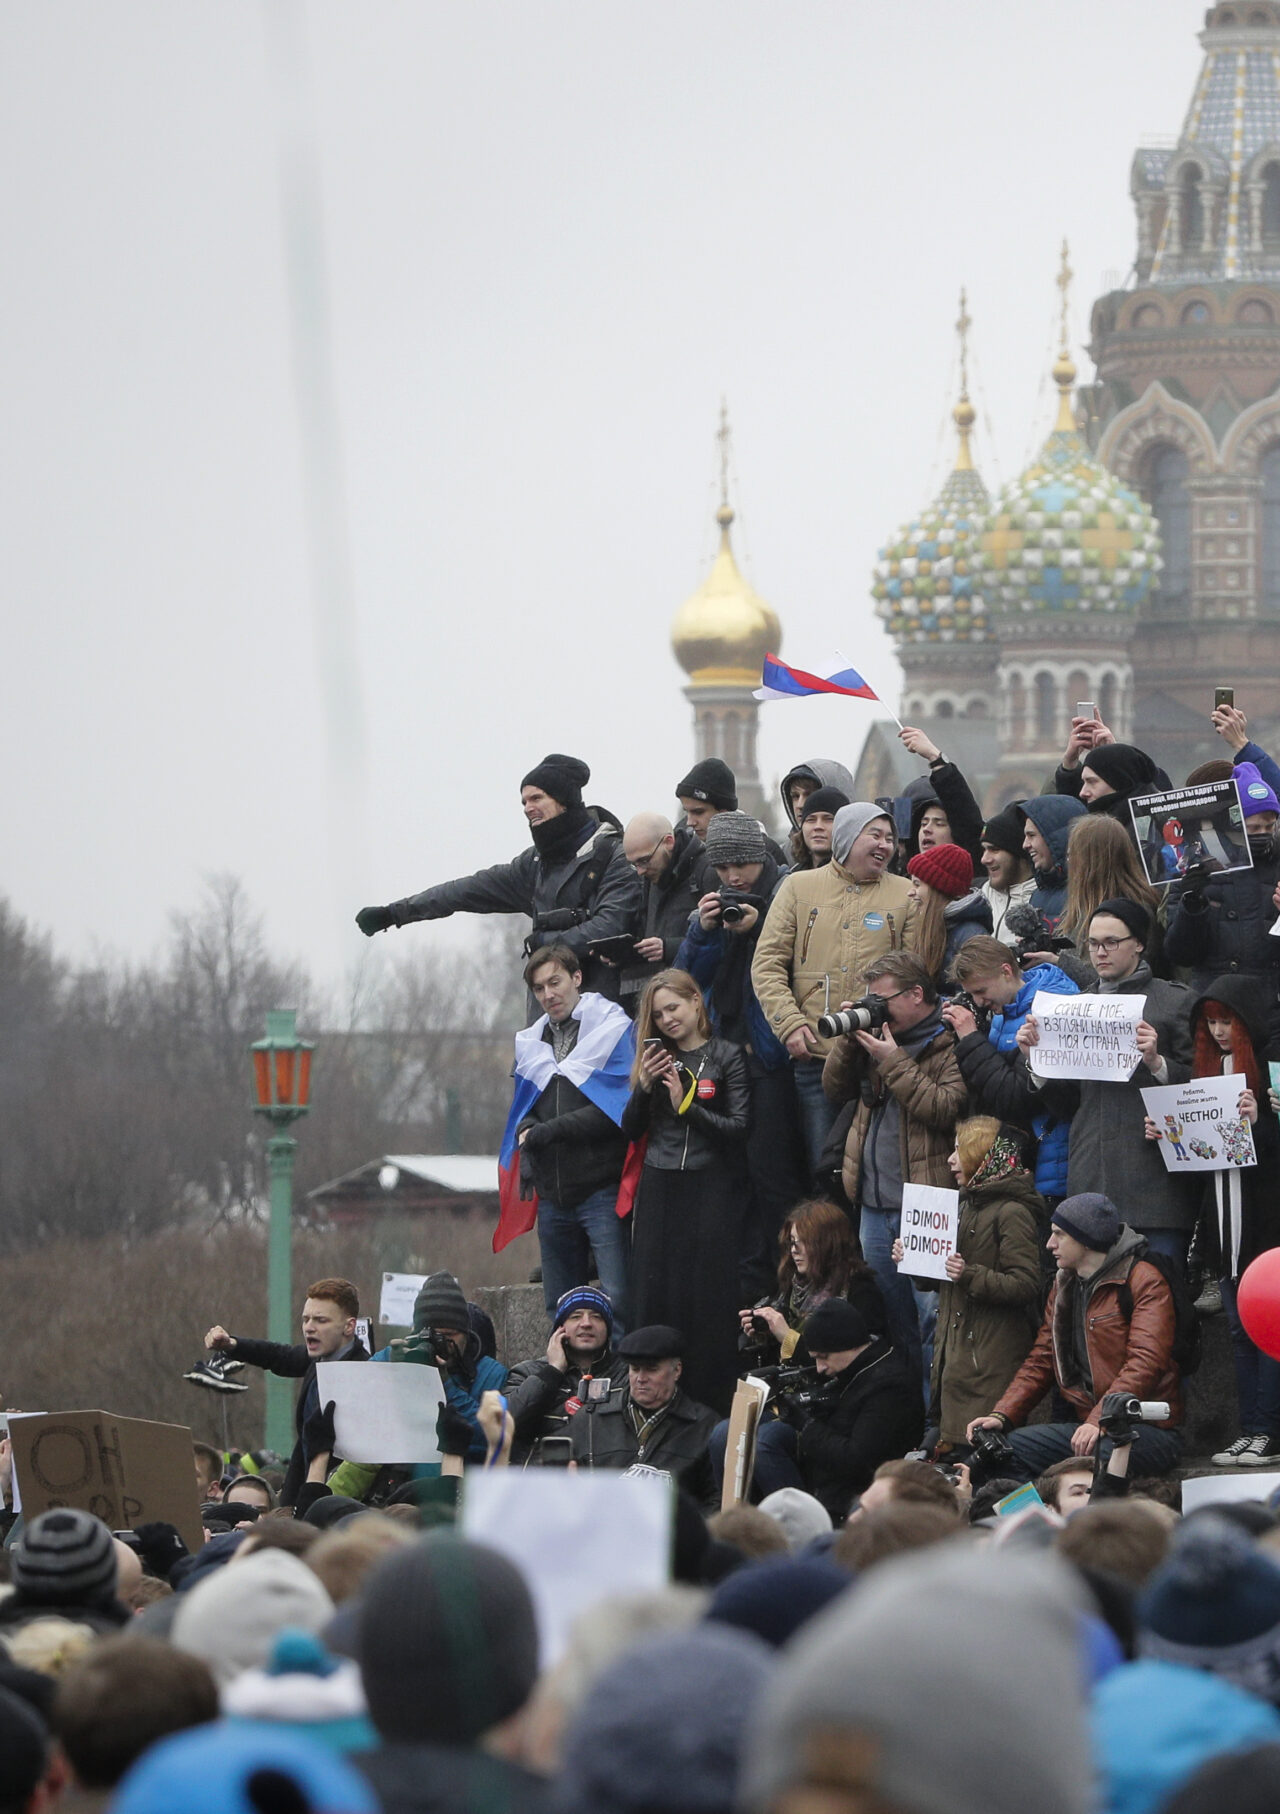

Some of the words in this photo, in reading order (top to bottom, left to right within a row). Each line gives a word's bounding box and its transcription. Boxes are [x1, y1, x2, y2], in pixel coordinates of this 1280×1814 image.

[1043, 1017, 1088, 1034] ВЗГЛЯНИ
[1091, 1020, 1102, 1034] НА
[1105, 1021, 1133, 1036] МЕНЯ
[1058, 1034, 1078, 1049] МОЯ
[1083, 1034, 1120, 1050] СТРАНА
[1034, 1049, 1104, 1068] ПРЕВРАТИЛАСЬ
[1108, 1052, 1114, 1068] В
[1178, 1108, 1223, 1123] ЧЕСТНО!
[912, 1209, 949, 1231] DIMON
[910, 1234, 952, 1256] DIMOFF
